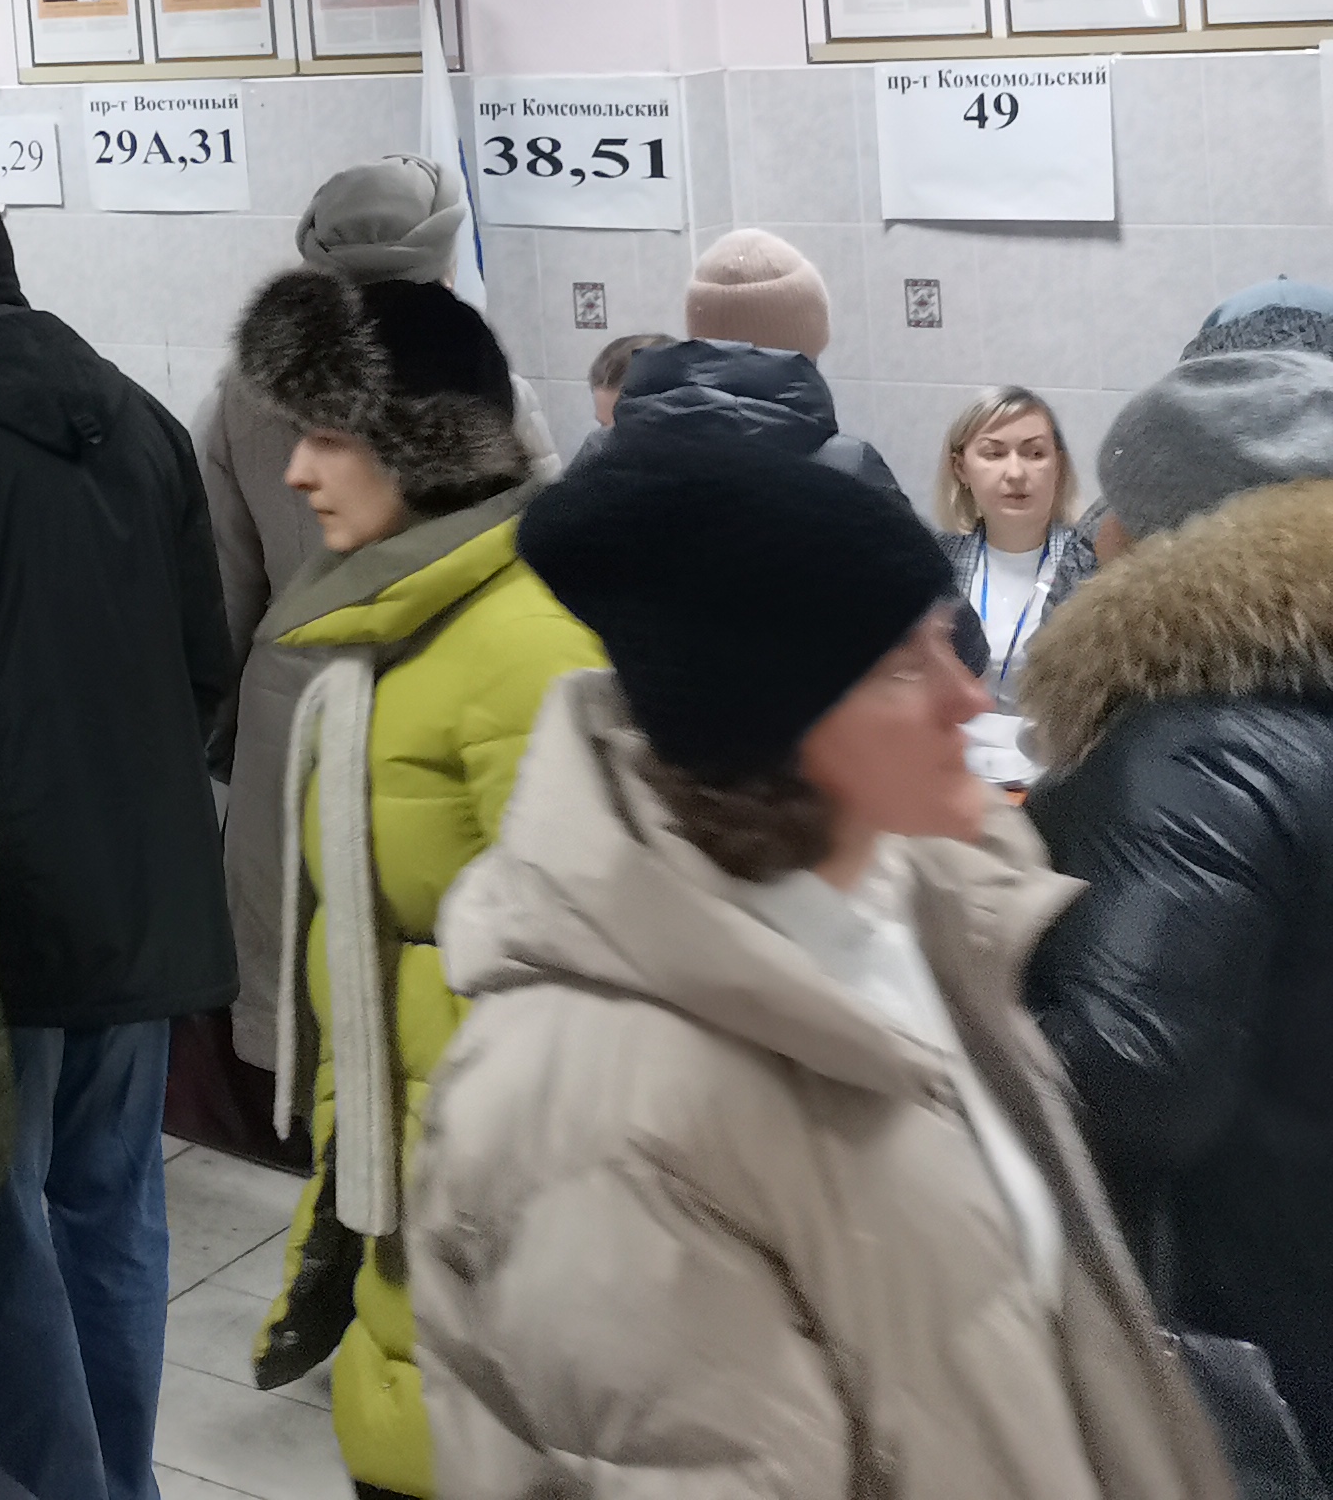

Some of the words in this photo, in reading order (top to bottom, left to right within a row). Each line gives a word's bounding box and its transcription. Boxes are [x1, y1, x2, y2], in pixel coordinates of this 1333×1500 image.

[887, 74, 931, 95] пр-т
[937, 67, 1108, 90] Комсомольский
[90, 98, 129, 117] пр-т
[133, 94, 239, 113] Восточный
[479, 101, 517, 121] пр-т
[522, 98, 670, 117] Комсомольский
[963, 92, 1020, 130] 49
[93, 128, 237, 173] 29А,31
[482, 135, 671, 188] 38,51
